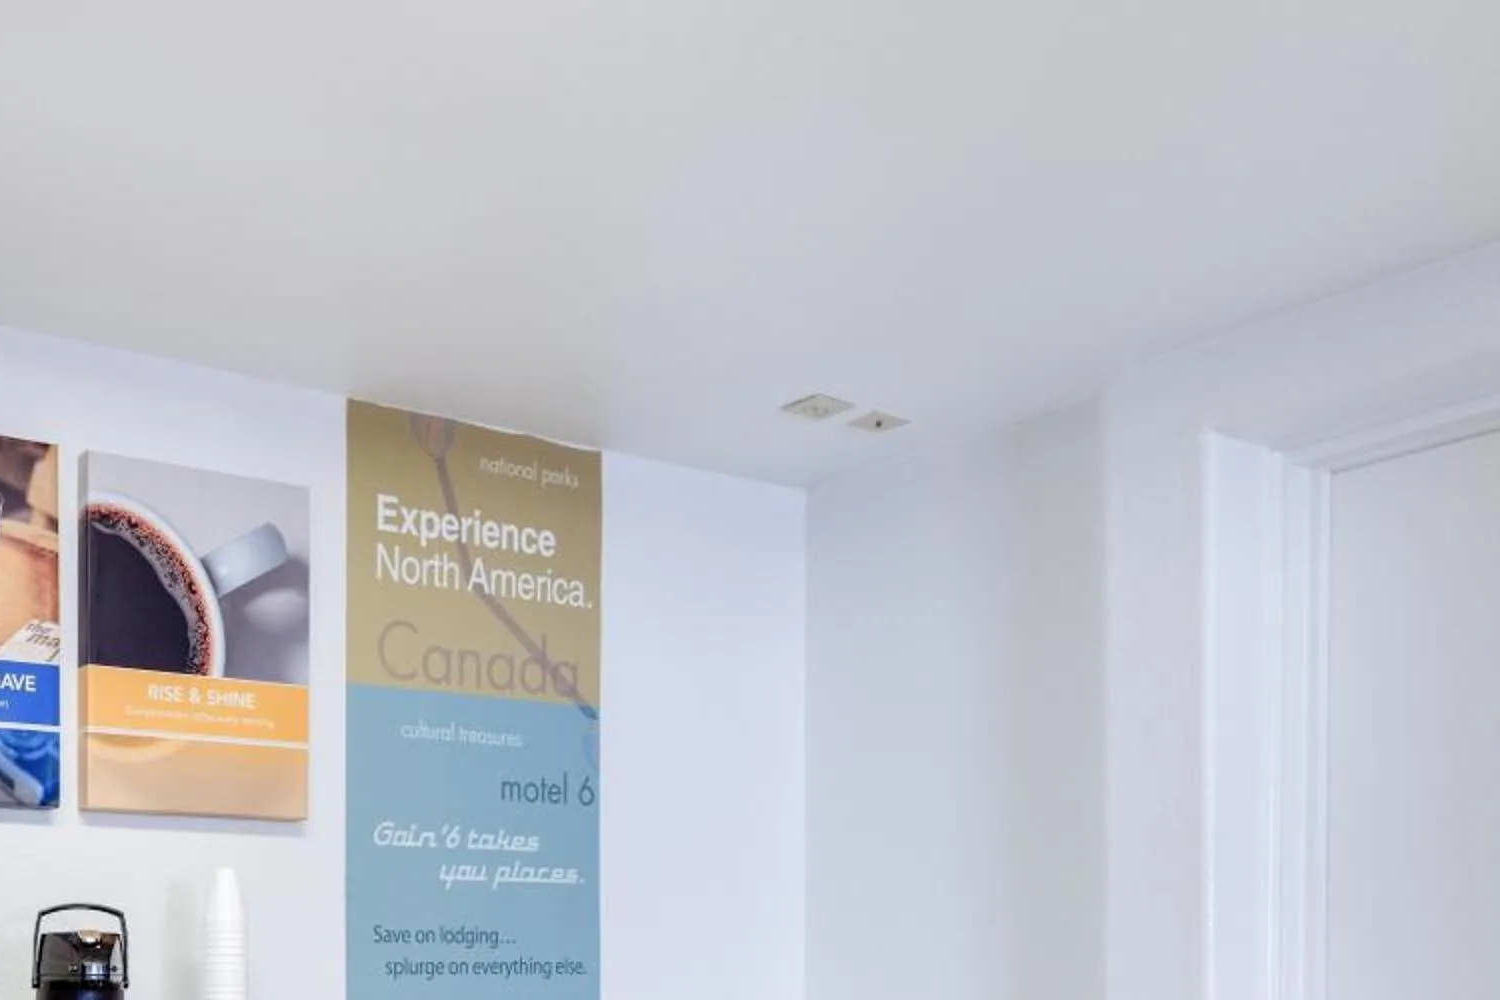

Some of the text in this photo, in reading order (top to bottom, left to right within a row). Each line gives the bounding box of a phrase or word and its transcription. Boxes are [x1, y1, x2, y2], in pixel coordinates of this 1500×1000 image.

[479, 456, 579, 488] national parks
[376, 493, 557, 557] Experience
[375, 542, 593, 609] North America.
[377, 619, 579, 697] Canada
[148, 684, 257, 710] RISE & SHINE
[400, 720, 523, 747] cultural treasures
[500, 771, 596, 806] motel 6
[467, 830, 540, 852] takes
[439, 861, 585, 890] you places.
[373, 924, 517, 949] Save on lodging...
[385, 957, 588, 980] splurge on everything else.
